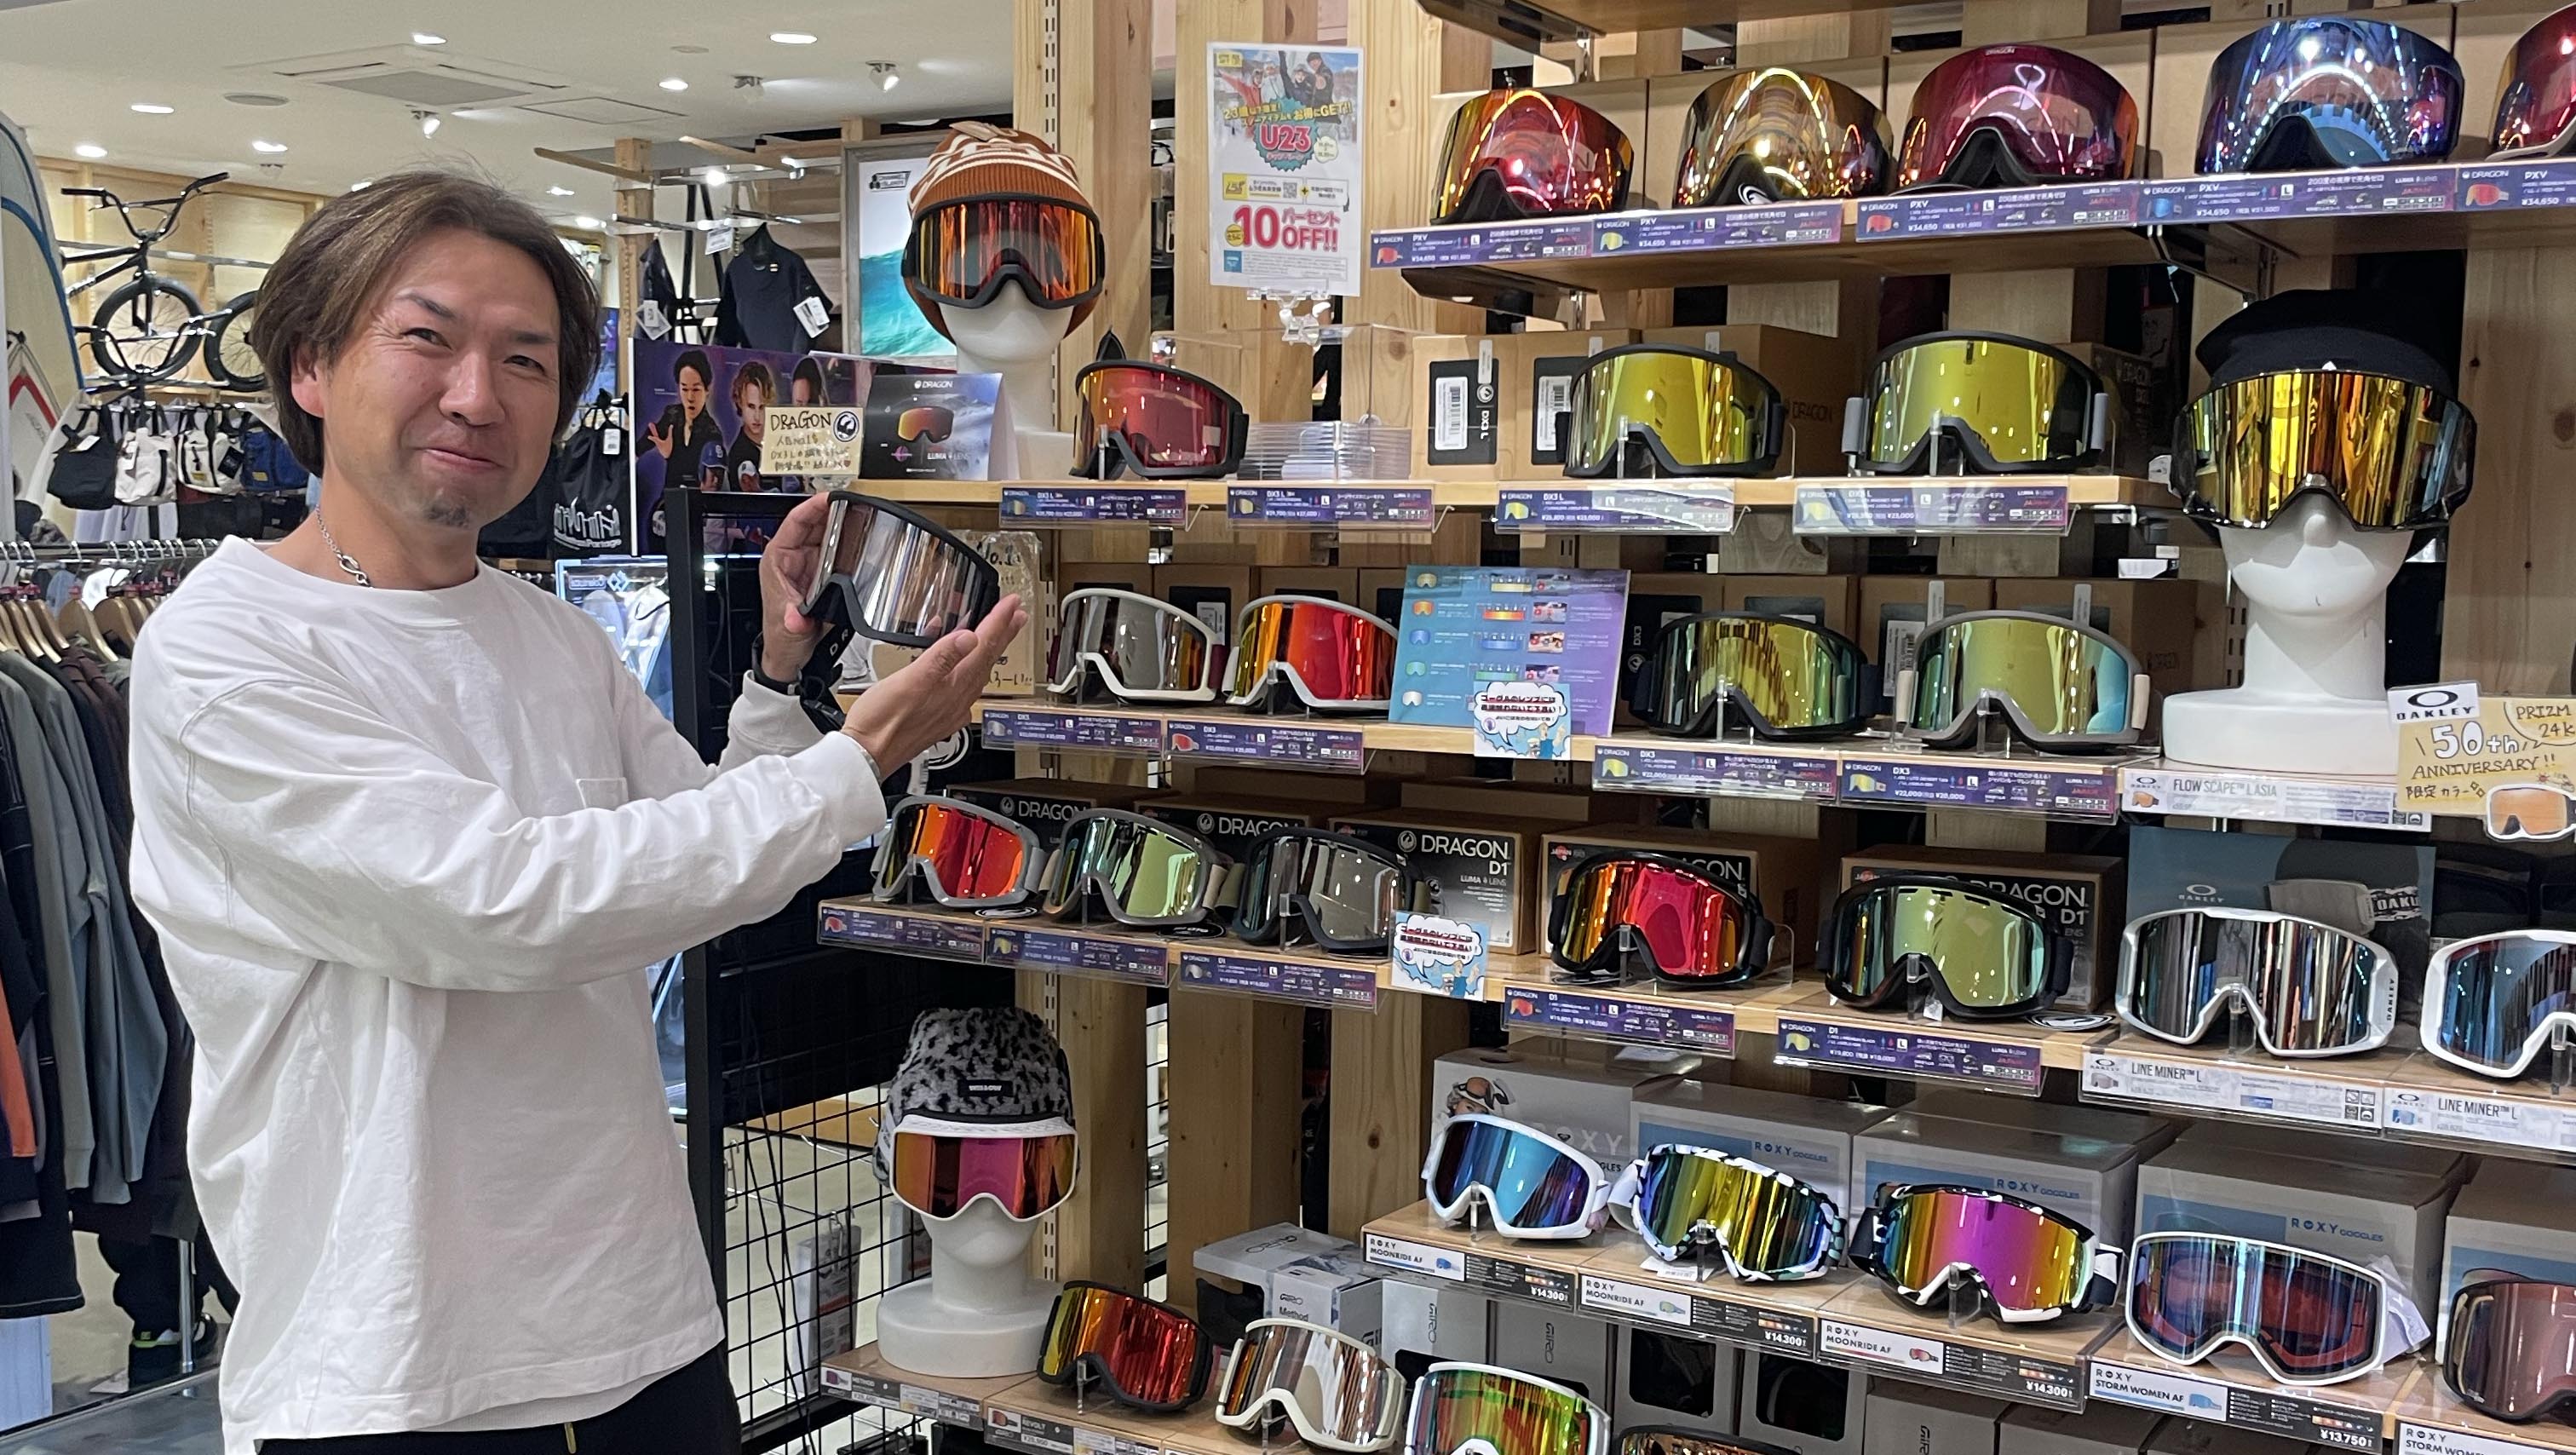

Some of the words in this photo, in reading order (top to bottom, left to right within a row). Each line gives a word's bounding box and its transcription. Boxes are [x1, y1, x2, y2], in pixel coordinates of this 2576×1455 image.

[1260, 124, 1312, 152] U23
[2471, 170, 2509, 178] DRAGON
[2524, 170, 2548, 180] PXV
[2199, 184, 2219, 193] PXV
[1910, 200, 1929, 209] PXV
[2521, 197, 2560, 205] ¥34,650
[1282, 207, 1341, 227] パーセント
[1602, 220, 1630, 228] DRAGON
[1640, 217, 1657, 226] PXV
[1233, 204, 1279, 249] 10
[1282, 225, 1338, 251] OFF!!
[1412, 233, 1428, 242] PXV
[922, 380, 954, 388] DRAGON
[770, 411, 832, 432] DRAGON
[1481, 410, 1489, 430] DX3
[1633, 625, 1642, 646] DX3
[1481, 694, 1555, 704] ゴーグルのレンズには
[2396, 706, 2475, 721] OAKLEY
[2516, 704, 2572, 720] PRIZM
[2430, 721, 2519, 759] 50th
[1893, 767, 1910, 775] DX3
[2173, 779, 2201, 792] FLOW
[1018, 801, 1086, 821] DRAGO
[1218, 816, 1298, 837] DRAG
[1421, 834, 1508, 860] DRAGON
[1489, 860, 1507, 876] D1
[1460, 875, 1481, 883] LUMA
[1489, 877, 1506, 886] LENS
[2377, 897, 2420, 911] OAKL
[2061, 909, 2086, 925] D1
[1513, 990, 1538, 998] DRAGON
[2387, 978, 2395, 1021] OAKLEY
[1788, 1023, 1816, 1032] DRAGON
[2131, 1061, 2153, 1076] LINE
[2438, 1097, 2462, 1113] LINE
[2511, 1107, 2518, 1120] L
[1533, 1123, 1623, 1156] OXY
[1754, 1141, 1792, 1156] ROXY
[1792, 1152, 1828, 1163] GOGGLES
[1600, 1161, 1622, 1172] GLES
[1997, 1178, 2038, 1193] ROXY
[2040, 1188, 2080, 1199] GOGGLES
[2291, 1217, 2337, 1234] ROXY
[2339, 1228, 2384, 1242] GOGGLES
[1370, 1238, 1397, 1248] ROXY
[1370, 1248, 1412, 1262] MOONRIDE
[1585, 1280, 1615, 1291] ROXY
[1279, 1293, 1303, 1305] GIRO
[1585, 1290, 1632, 1303] MOONRIDE
[1279, 1306, 1309, 1321] Method
[1428, 1303, 1438, 1343] GIRO
[1826, 1325, 1860, 1337] ROXY
[1544, 1322, 1555, 1363] GIRO
[1826, 1335, 1877, 1351] MOONRIDE
[1879, 1345, 1892, 1354] AF
[2096, 1369, 2132, 1381] ROXY
[2096, 1379, 2128, 1393] STORM
[2129, 1385, 2171, 1400] WOMEN
[2171, 1393, 2185, 1402] AF
[1920, 1425, 1929, 1455] GIR
[2406, 1428, 2447, 1442] ROXY
[2406, 1440, 2443, 1452] STORM
